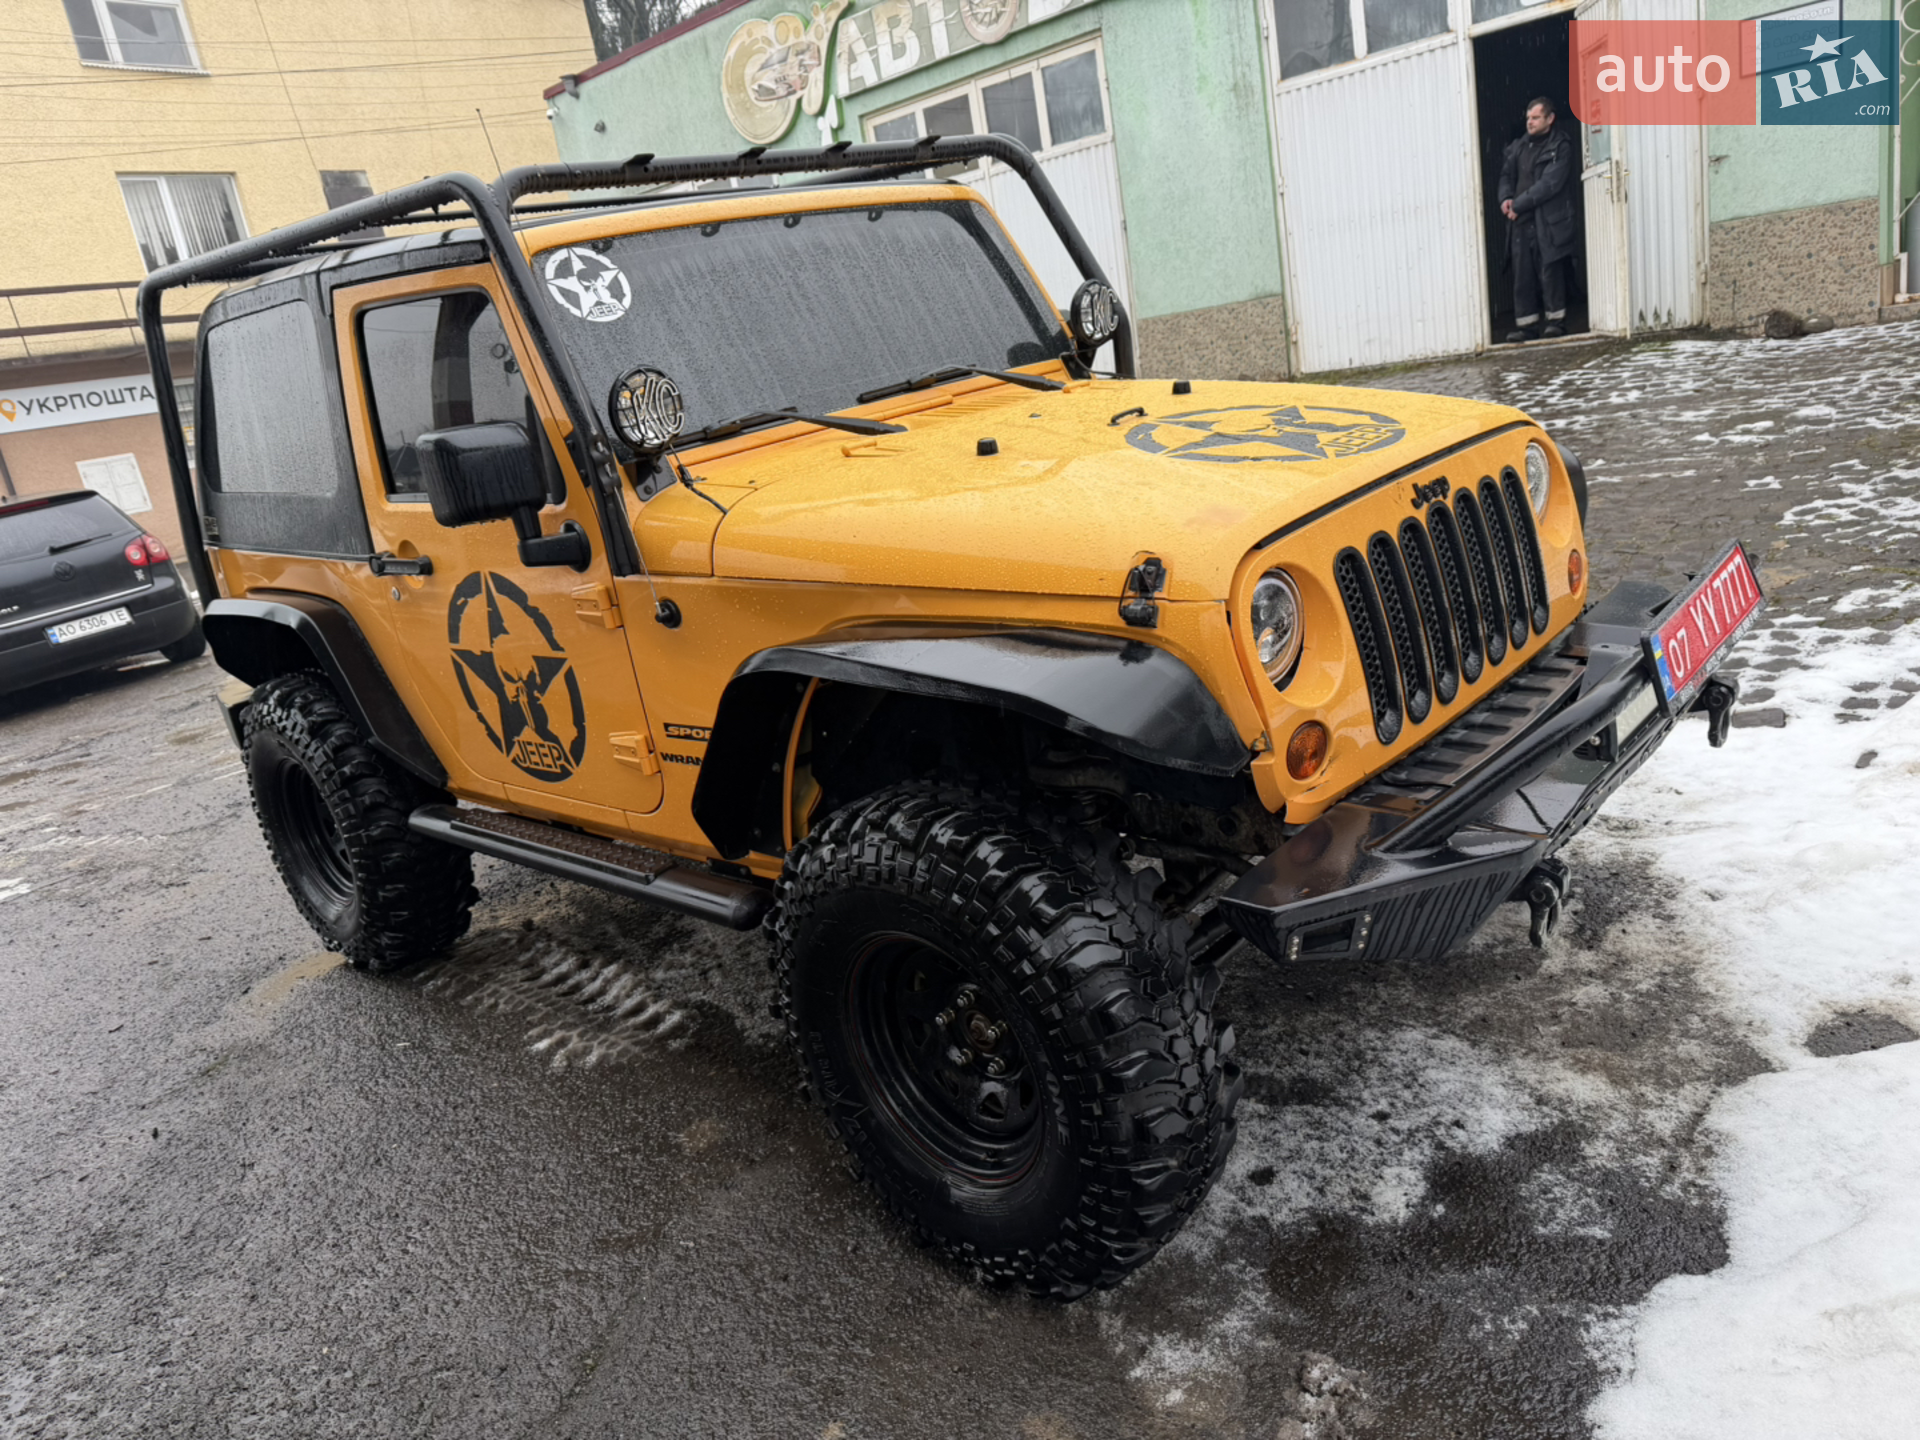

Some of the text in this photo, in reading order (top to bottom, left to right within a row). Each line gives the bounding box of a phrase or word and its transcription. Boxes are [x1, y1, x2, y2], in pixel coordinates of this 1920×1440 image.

[589, 303, 618, 318] JEEP
[17, 385, 156, 415] УКРПОШТА
[633, 376, 684, 441] KC
[1320, 426, 1393, 454] JEEP
[1411, 475, 1450, 509] Jeep
[57, 609, 127, 638] AO 6306 IE
[1668, 627, 1691, 678] 07
[514, 739, 564, 773] JEEP
